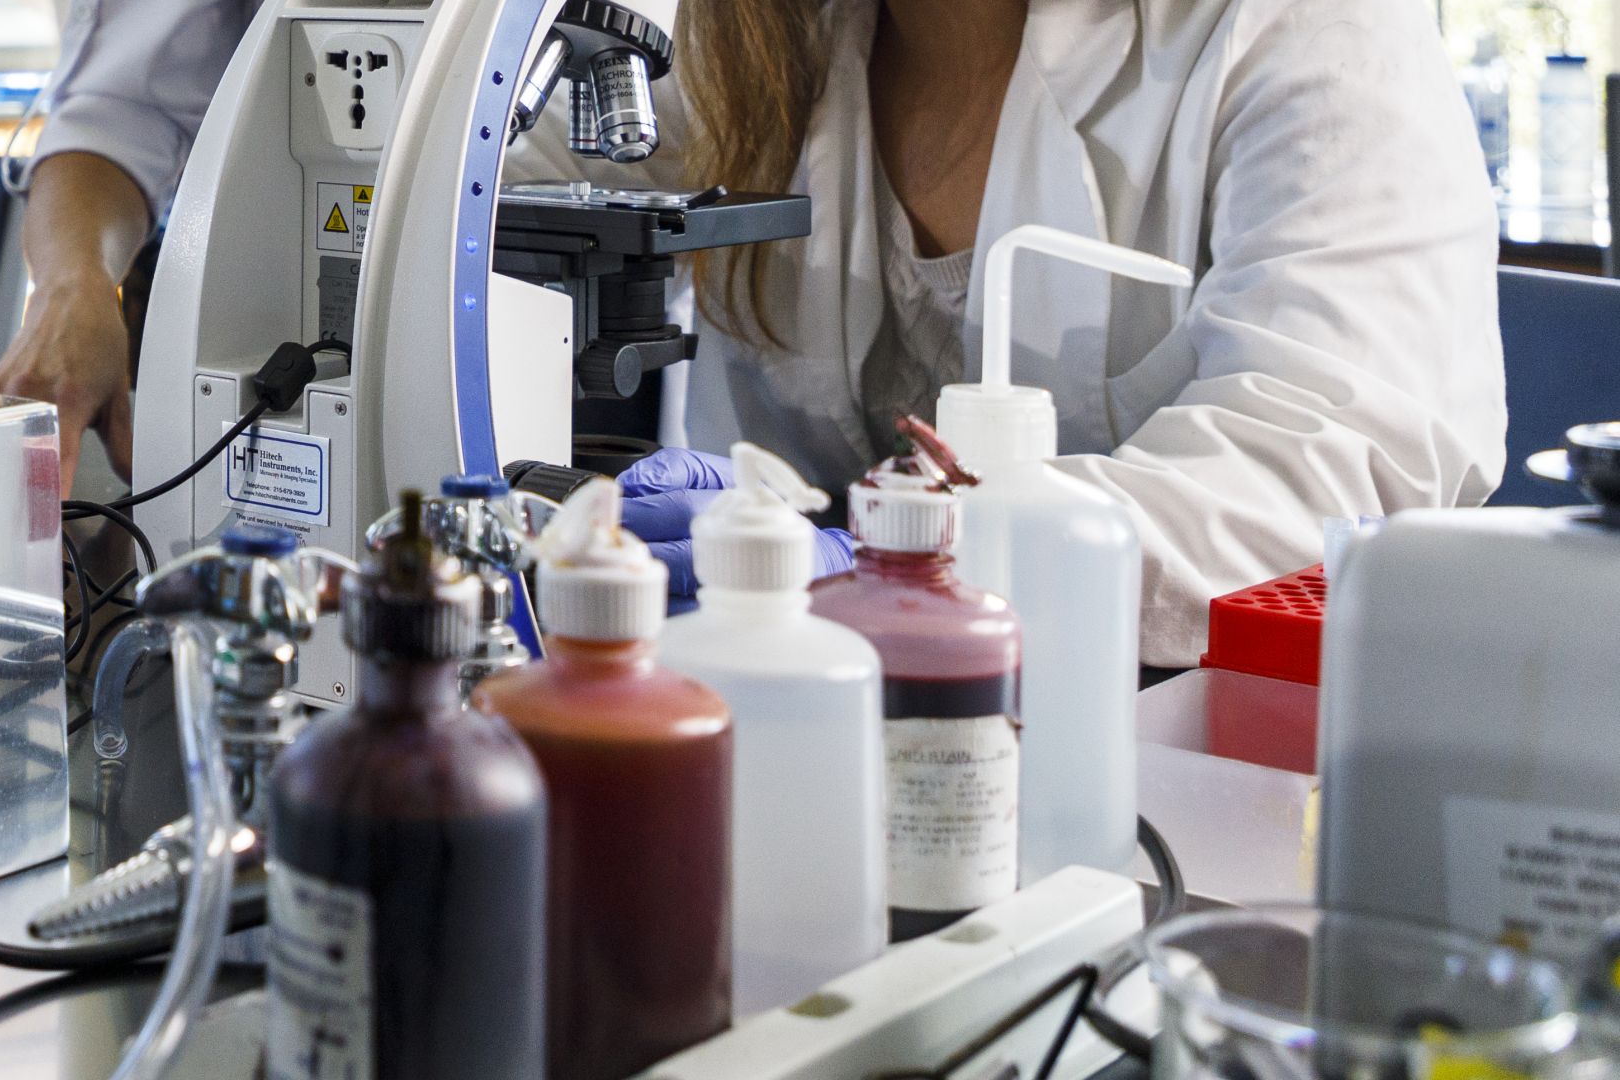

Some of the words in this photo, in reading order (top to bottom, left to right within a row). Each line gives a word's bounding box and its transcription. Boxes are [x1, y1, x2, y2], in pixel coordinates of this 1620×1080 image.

[233, 445, 258, 472] HT
[260, 450, 283, 461] Hitech
[260, 459, 303, 475] Instruments,
[305, 466, 318, 477] Inc.
